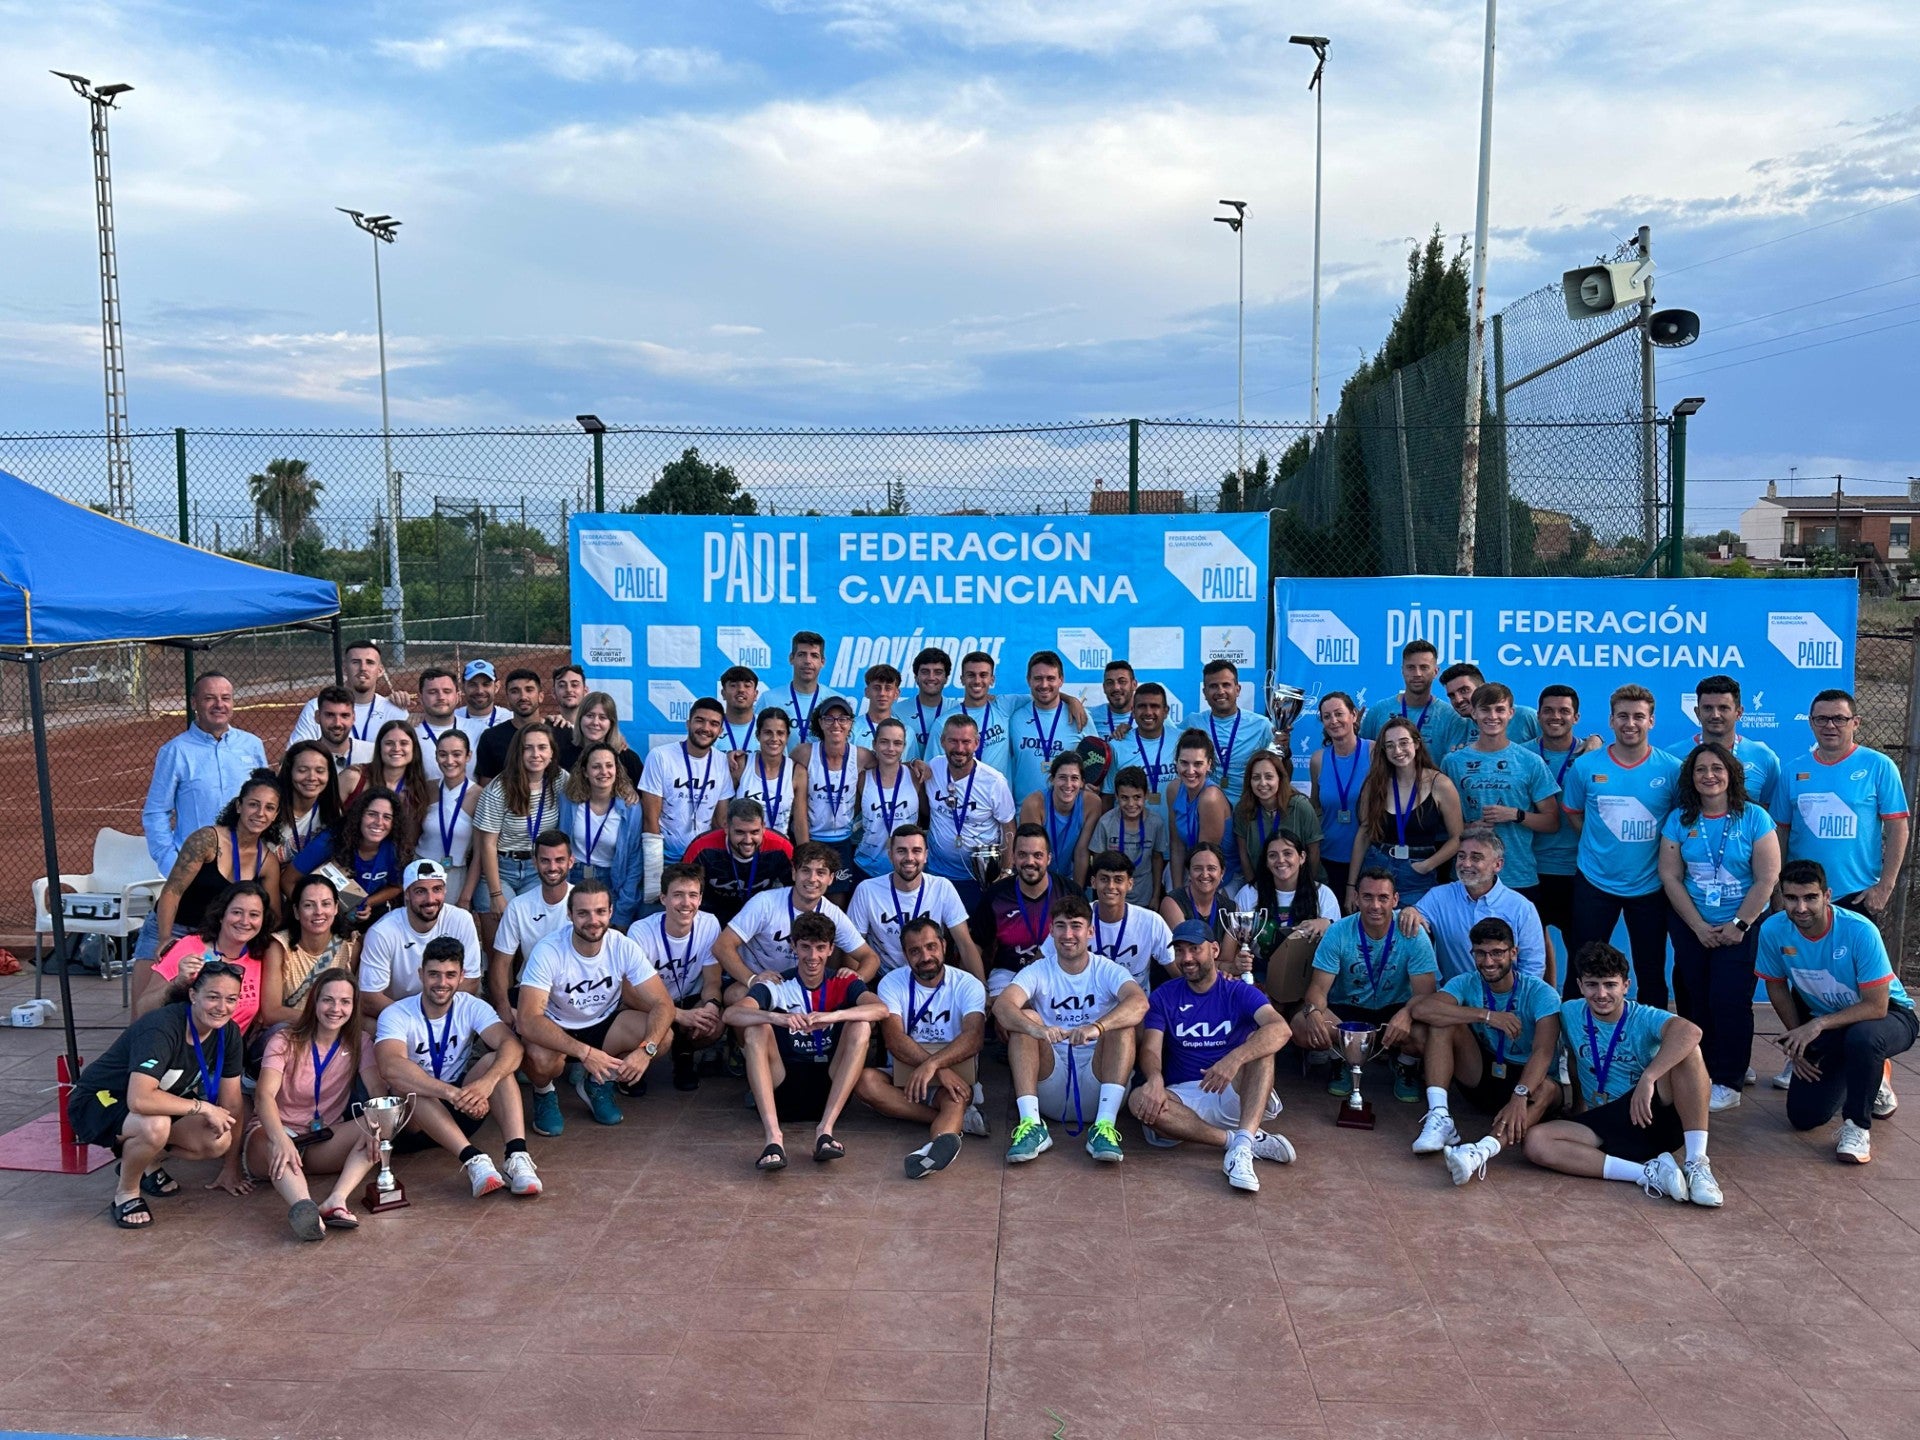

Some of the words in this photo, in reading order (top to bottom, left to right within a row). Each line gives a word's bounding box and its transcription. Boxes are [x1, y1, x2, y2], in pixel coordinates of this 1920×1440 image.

[838, 523, 1091, 562] FEDERACIÓN
[837, 575, 1139, 605] C.VALENCIANA
[1498, 604, 1707, 634] FEDERACIÓN
[1497, 643, 1745, 668] C.VALENCIANA
[1176, 1020, 1232, 1037] KIA
[1182, 1040, 1203, 1048] Grupo
